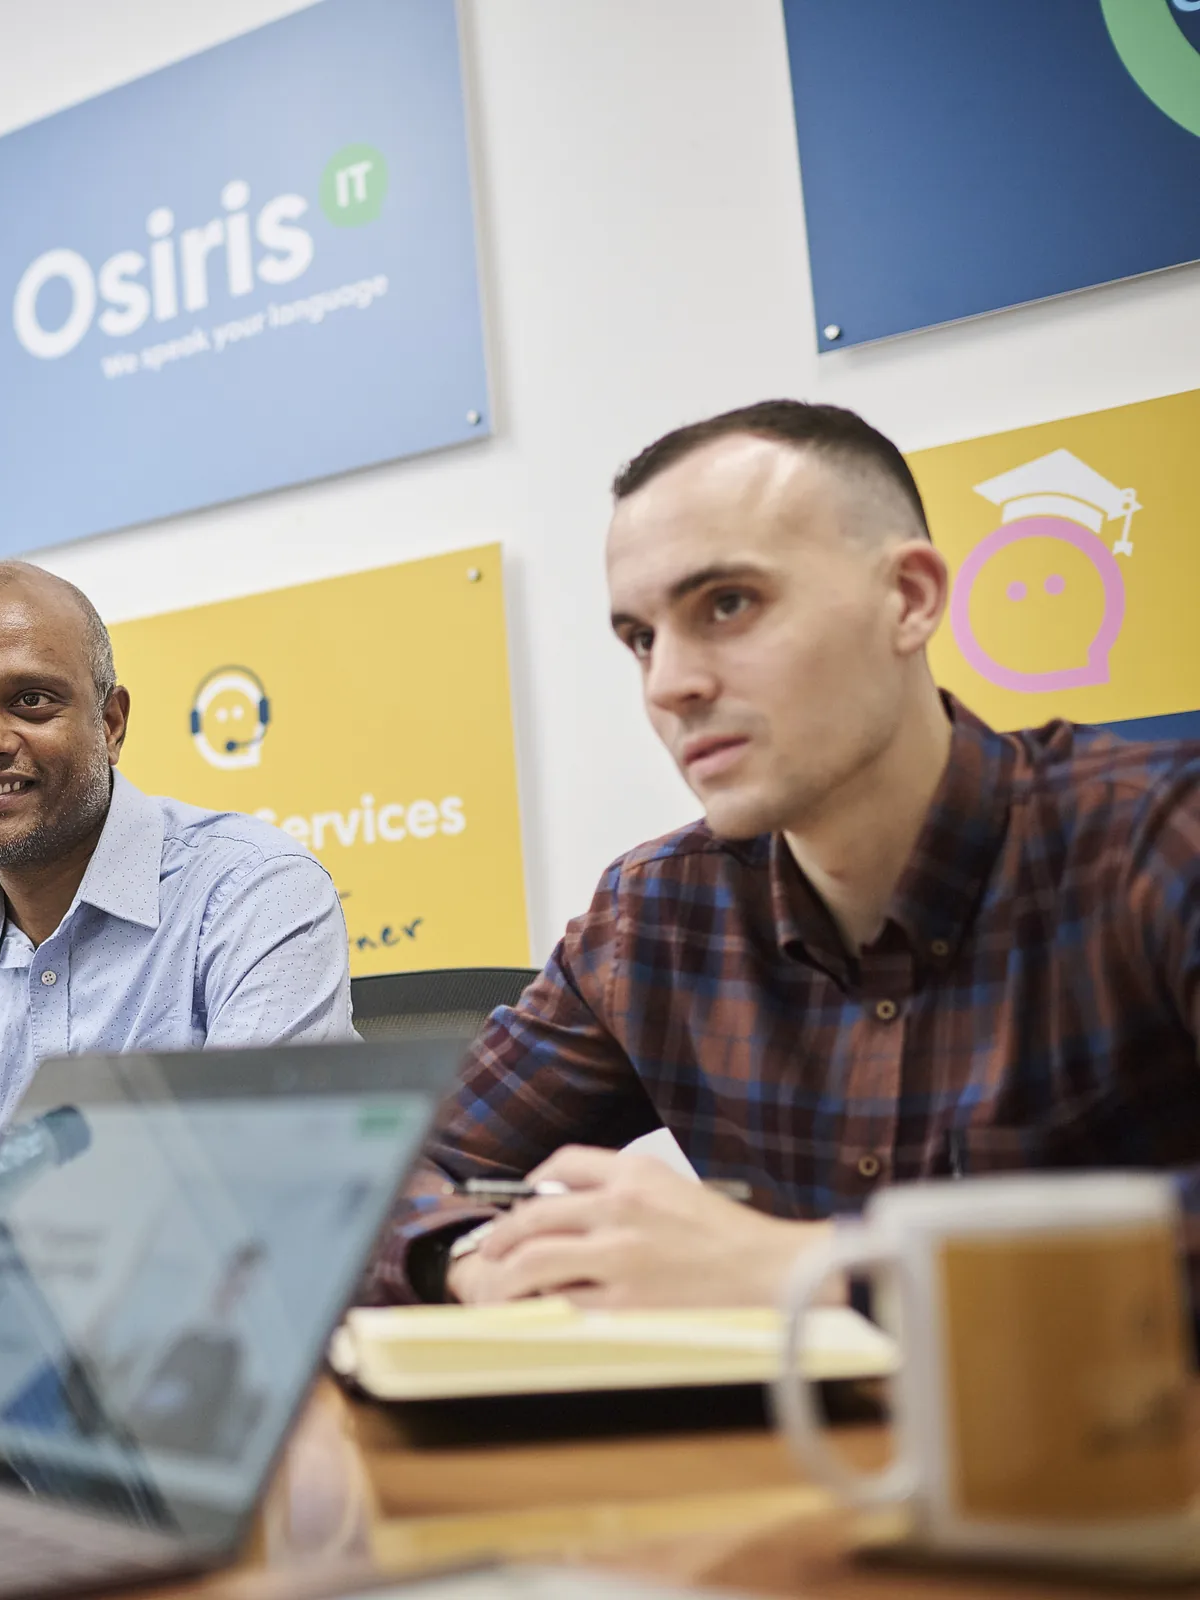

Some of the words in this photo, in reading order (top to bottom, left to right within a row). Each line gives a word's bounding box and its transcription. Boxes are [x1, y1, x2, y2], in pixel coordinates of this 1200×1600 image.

[13, 180, 314, 360] Osiris
[335, 160, 373, 208] IT
[102, 354, 138, 379] We
[141, 327, 210, 371] speak
[212, 312, 265, 352] your
[267, 274, 389, 328] language
[350, 917, 424, 952] ner
